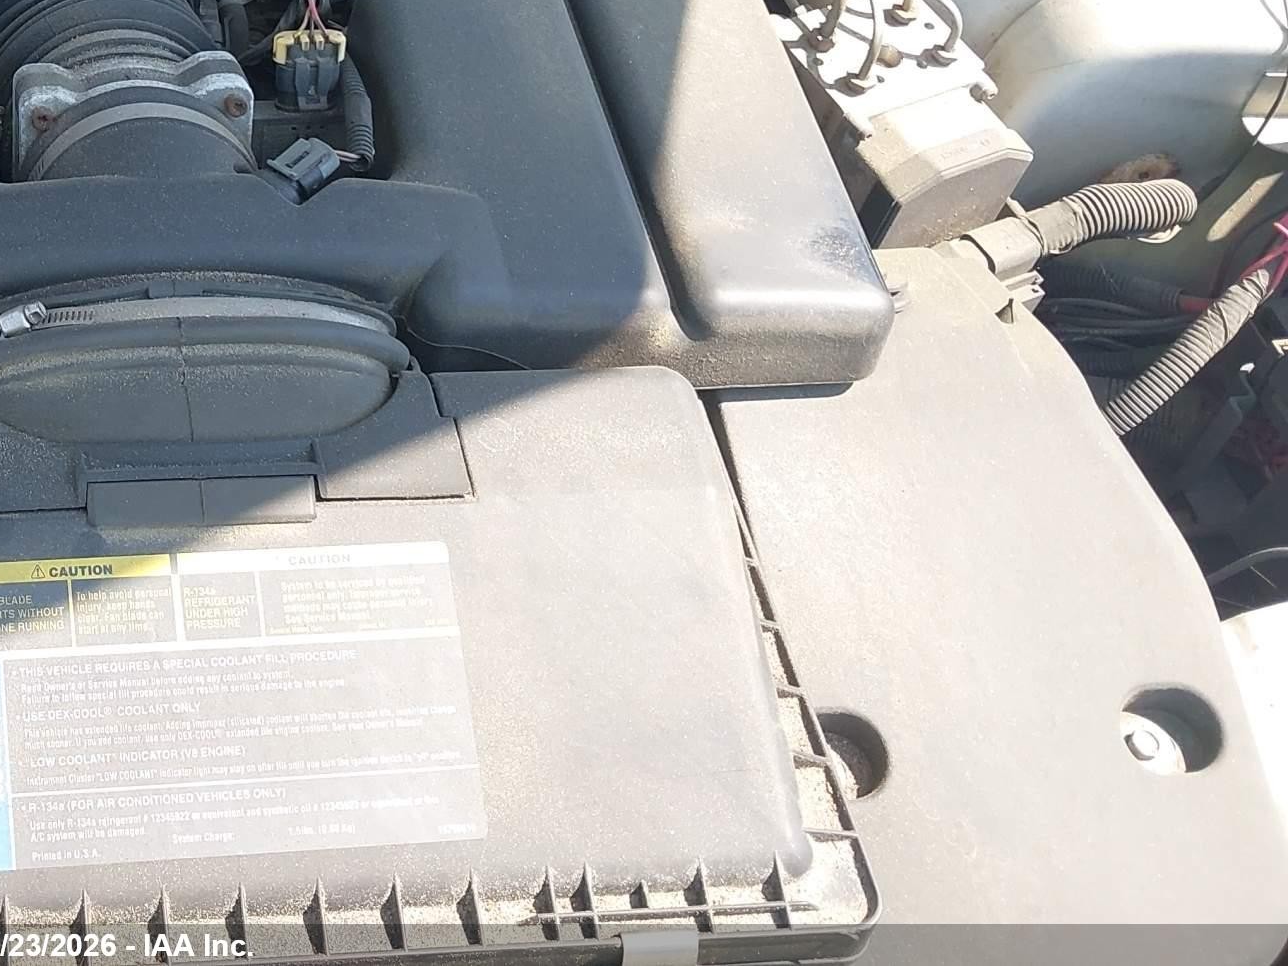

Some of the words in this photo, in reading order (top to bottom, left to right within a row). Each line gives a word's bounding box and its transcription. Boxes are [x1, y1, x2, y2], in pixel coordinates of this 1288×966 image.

[288, 554, 350, 566] CAUTION
[48, 564, 112, 577] CAUTION
[76, 591, 86, 601] To
[88, 590, 107, 600] help
[109, 589, 132, 599] avoid
[184, 594, 256, 605] REFRIGERANT
[16, 606, 64, 618] WITHOUT
[104, 613, 121, 622] Fan
[185, 608, 222, 618] UNDER
[224, 606, 248, 617] HIGH
[18, 620, 65, 632] RUNNING
[78, 624, 100, 634] start
[110, 623, 128, 633] any
[186, 618, 241, 629] PRESSURE
[19, 666, 44, 676] THIS
[46, 663, 92, 675] VEHICLE
[95, 661, 150, 673] REQUIRES
[152, 660, 160, 670] A
[162, 658, 208, 669] SPECIAL
[211, 655, 262, 667] COOLANT
[265, 654, 288, 664] FILL
[290, 650, 357, 663] PROCEDURE
[24, 712, 46, 722] USE
[117, 704, 170, 717] COOLANT
[172, 702, 201, 714] ONLY
[120, 749, 178, 762] INDICATOR
[201, 745, 246, 757] ENGINE)
[68, 798, 94, 810] (FOR
[96, 797, 115, 809] AIR
[118, 793, 194, 808] CONDITIONED
[196, 790, 250, 803] VEHICLES
[252, 788, 286, 800] ONLY)
[32, 851, 62, 861] Printed
[74, 849, 102, 859] U.S.A.
